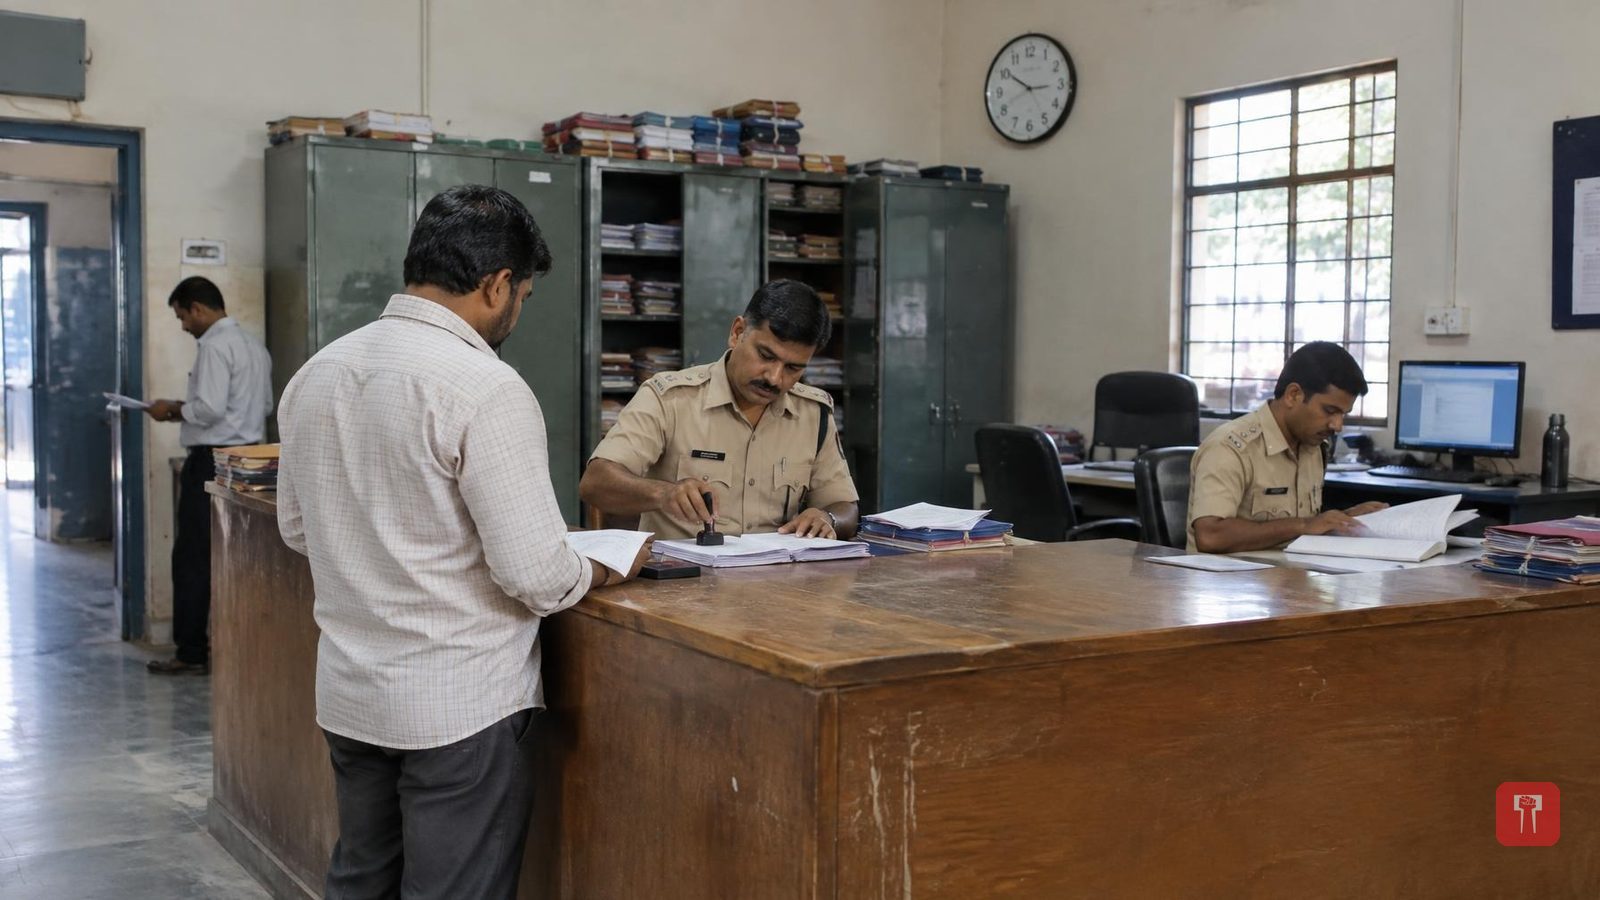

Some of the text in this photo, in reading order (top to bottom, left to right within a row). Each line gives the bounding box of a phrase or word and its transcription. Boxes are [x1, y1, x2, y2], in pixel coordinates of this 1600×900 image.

[1025, 45, 1036, 58] 12
[1011, 53, 1020, 65] 11
[1052, 60, 1060, 73] 2
[1000, 68, 1011, 80] 10
[1057, 78, 1065, 90] 3
[996, 86, 1003, 99] 9
[1051, 97, 1059, 110] 4
[1000, 104, 1008, 116] 8
[1011, 116, 1019, 128] 7
[1041, 112, 1048, 125] 5
[1026, 120, 1033, 132] 6
